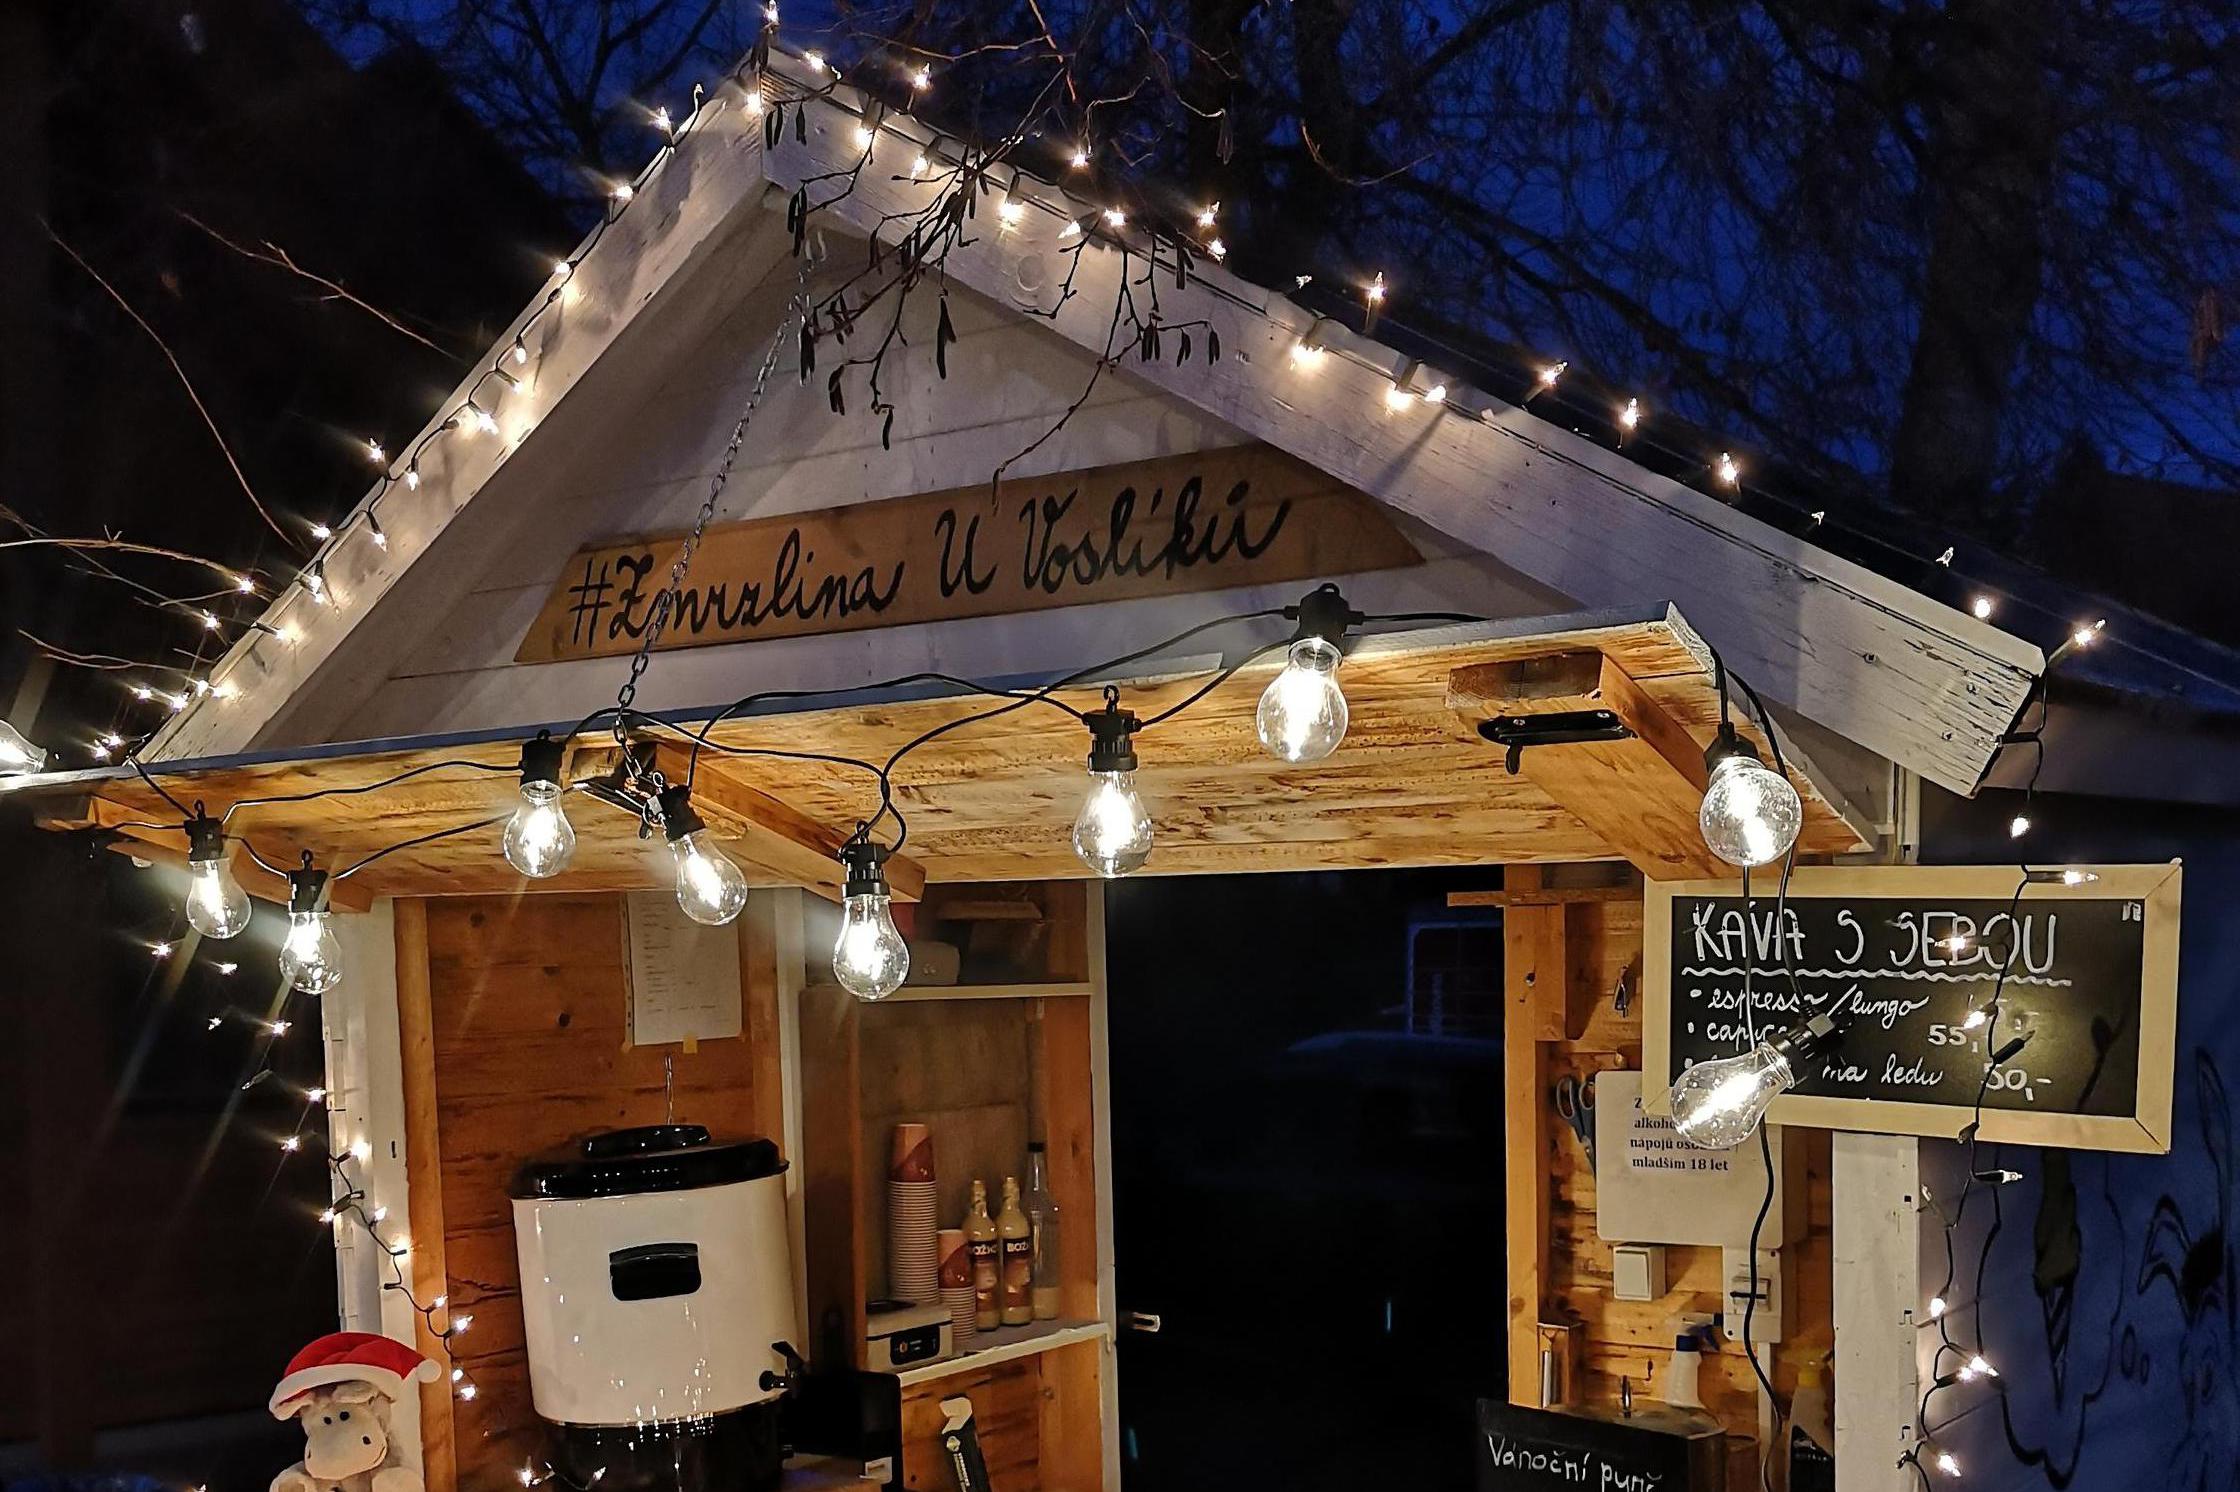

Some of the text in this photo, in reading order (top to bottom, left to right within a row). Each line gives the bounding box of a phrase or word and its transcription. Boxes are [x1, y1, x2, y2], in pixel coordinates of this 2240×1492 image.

[568, 527, 905, 649] #Zmrzlina
[934, 508, 997, 598] U
[1834, 908, 1865, 965] S
[1888, 911, 2057, 974] SEBOU
[1880, 1053, 1945, 1087] ledu
[1690, 1157, 1707, 1170] 18
[1710, 1158, 1729, 1171] let
[1487, 1433, 1591, 1483] Vánoční
